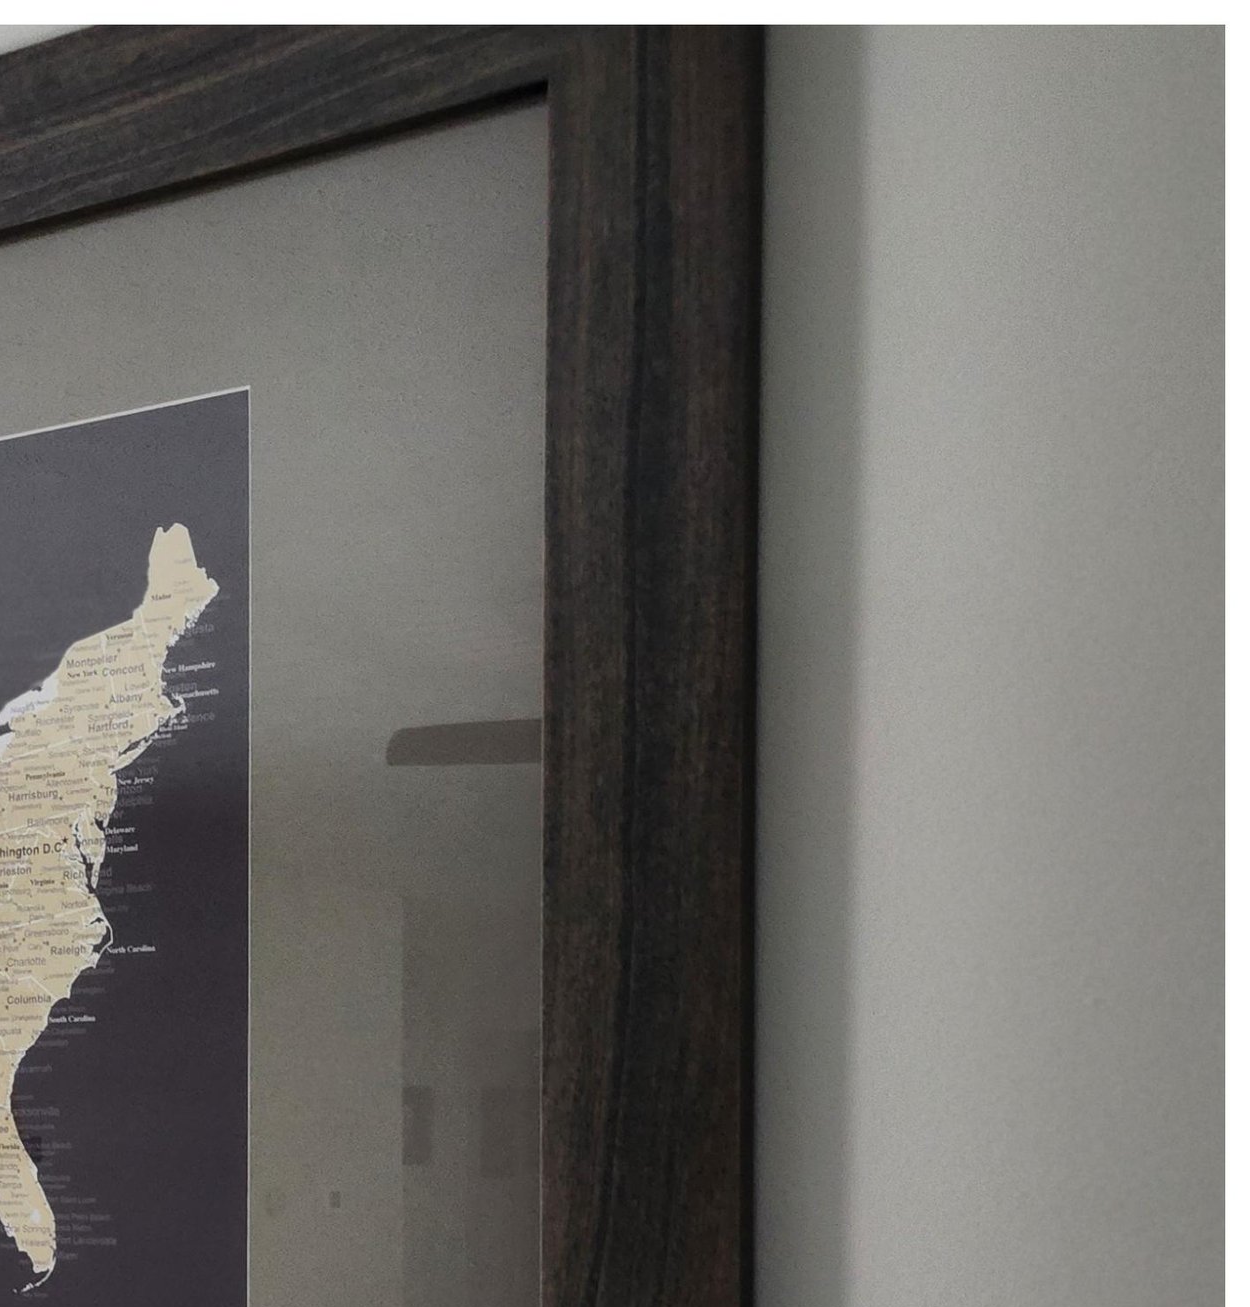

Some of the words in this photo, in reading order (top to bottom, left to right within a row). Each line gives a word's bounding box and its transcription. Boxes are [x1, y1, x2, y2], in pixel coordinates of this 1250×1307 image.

[66, 654, 118, 669] Montpelier
[178, 661, 216, 672] Hampshire
[101, 663, 144, 677] Concord
[110, 693, 143, 704] Albany
[88, 720, 128, 733] Hartford
[8, 790, 59, 803] Harrisburg
[105, 827, 135, 835] Delaware
[106, 844, 138, 853] Maryland
[51, 945, 87, 957] Raleigh
[7, 994, 52, 1006] Columbia
